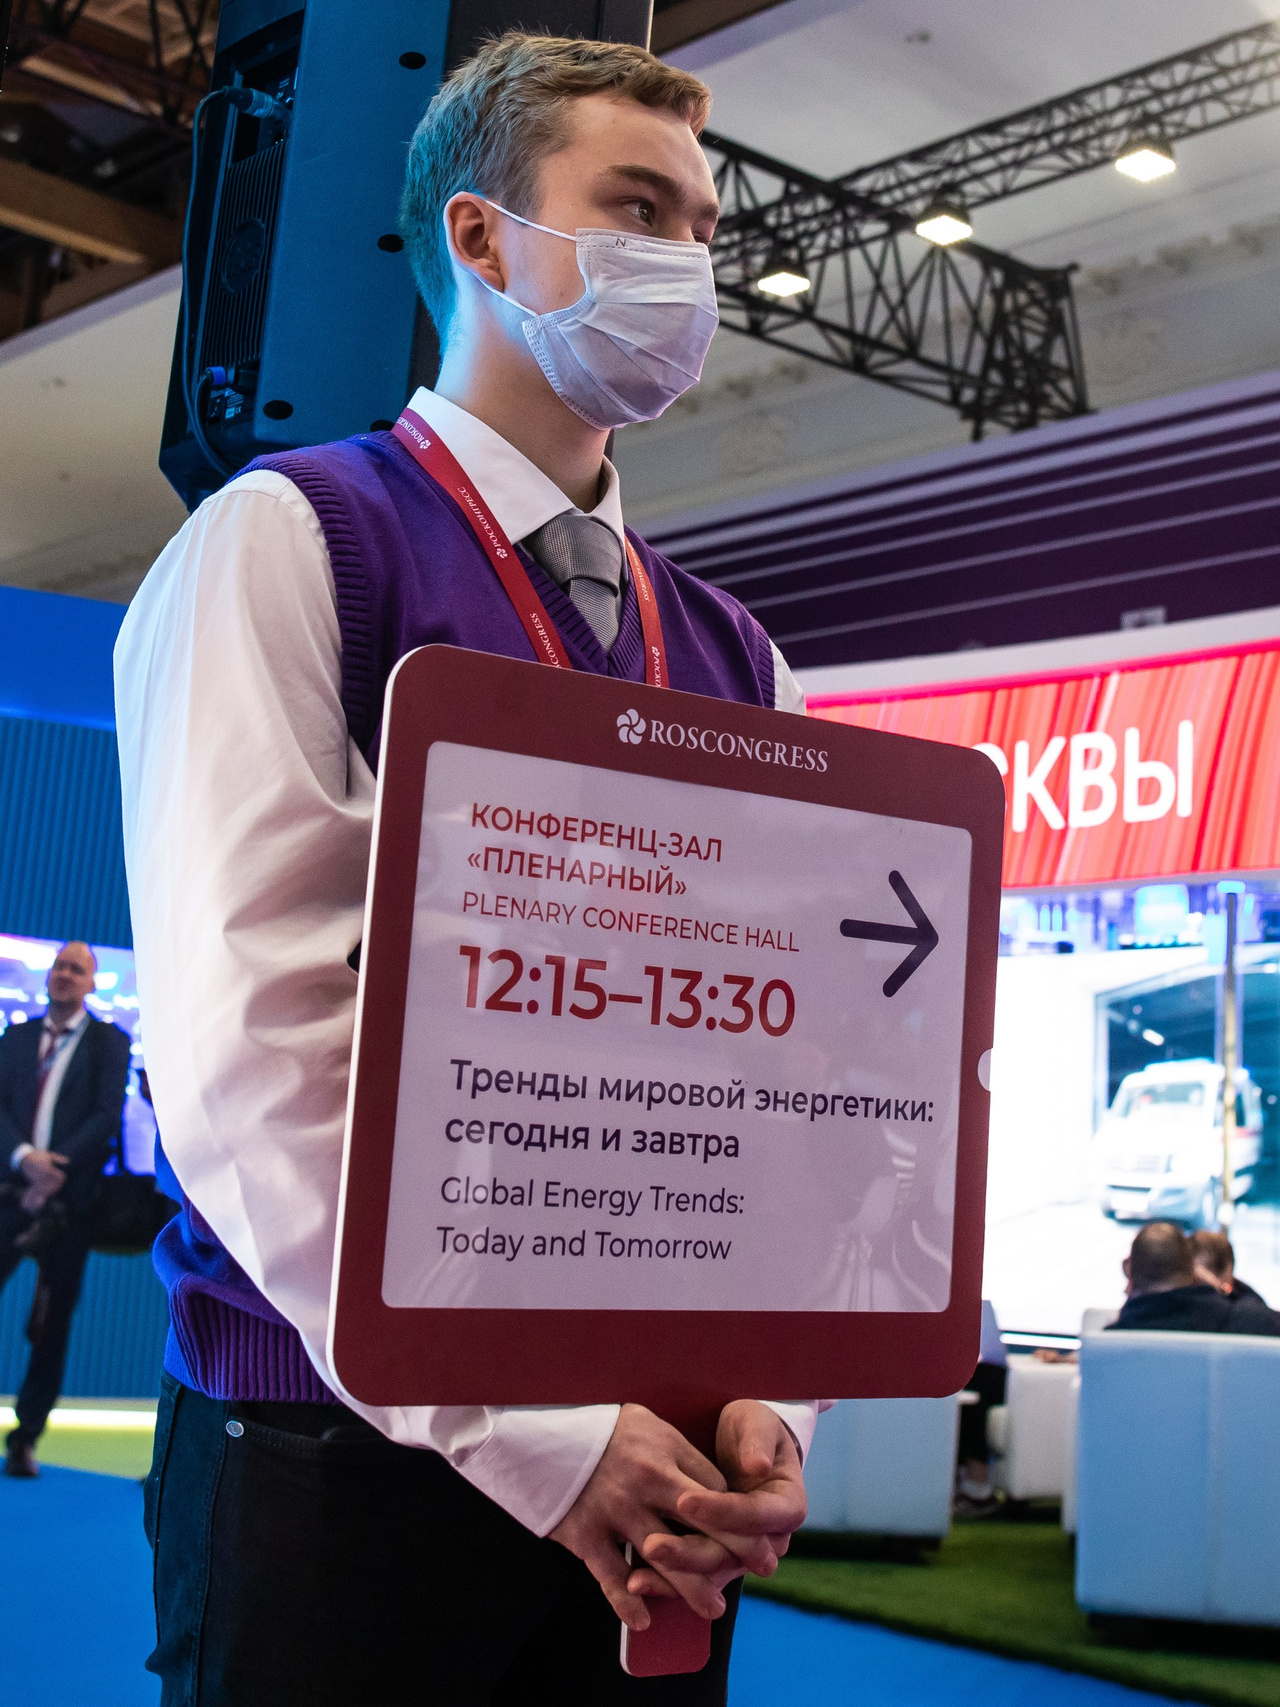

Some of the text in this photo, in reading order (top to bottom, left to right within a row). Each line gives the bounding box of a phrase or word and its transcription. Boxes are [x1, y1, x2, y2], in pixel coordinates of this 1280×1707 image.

[457, 486, 502, 548] РОСКОНГРЕСС
[650, 720, 828, 772] ROSCONGRESS
[472, 803, 723, 862] КОНФЕРЕНЦ-ЗАЛ
[467, 846, 688, 896] «ПЛЕНАРНЫЙ»
[463, 891, 799, 952] PLENARY CONFERENCE HALL
[450, 1059, 934, 1122] Тренды мировой энергетики:
[445, 1117, 740, 1164] сегодня и завтра
[441, 1176, 745, 1217] Global Energy Trends:
[437, 1226, 732, 1261] Today and Tomorrow
